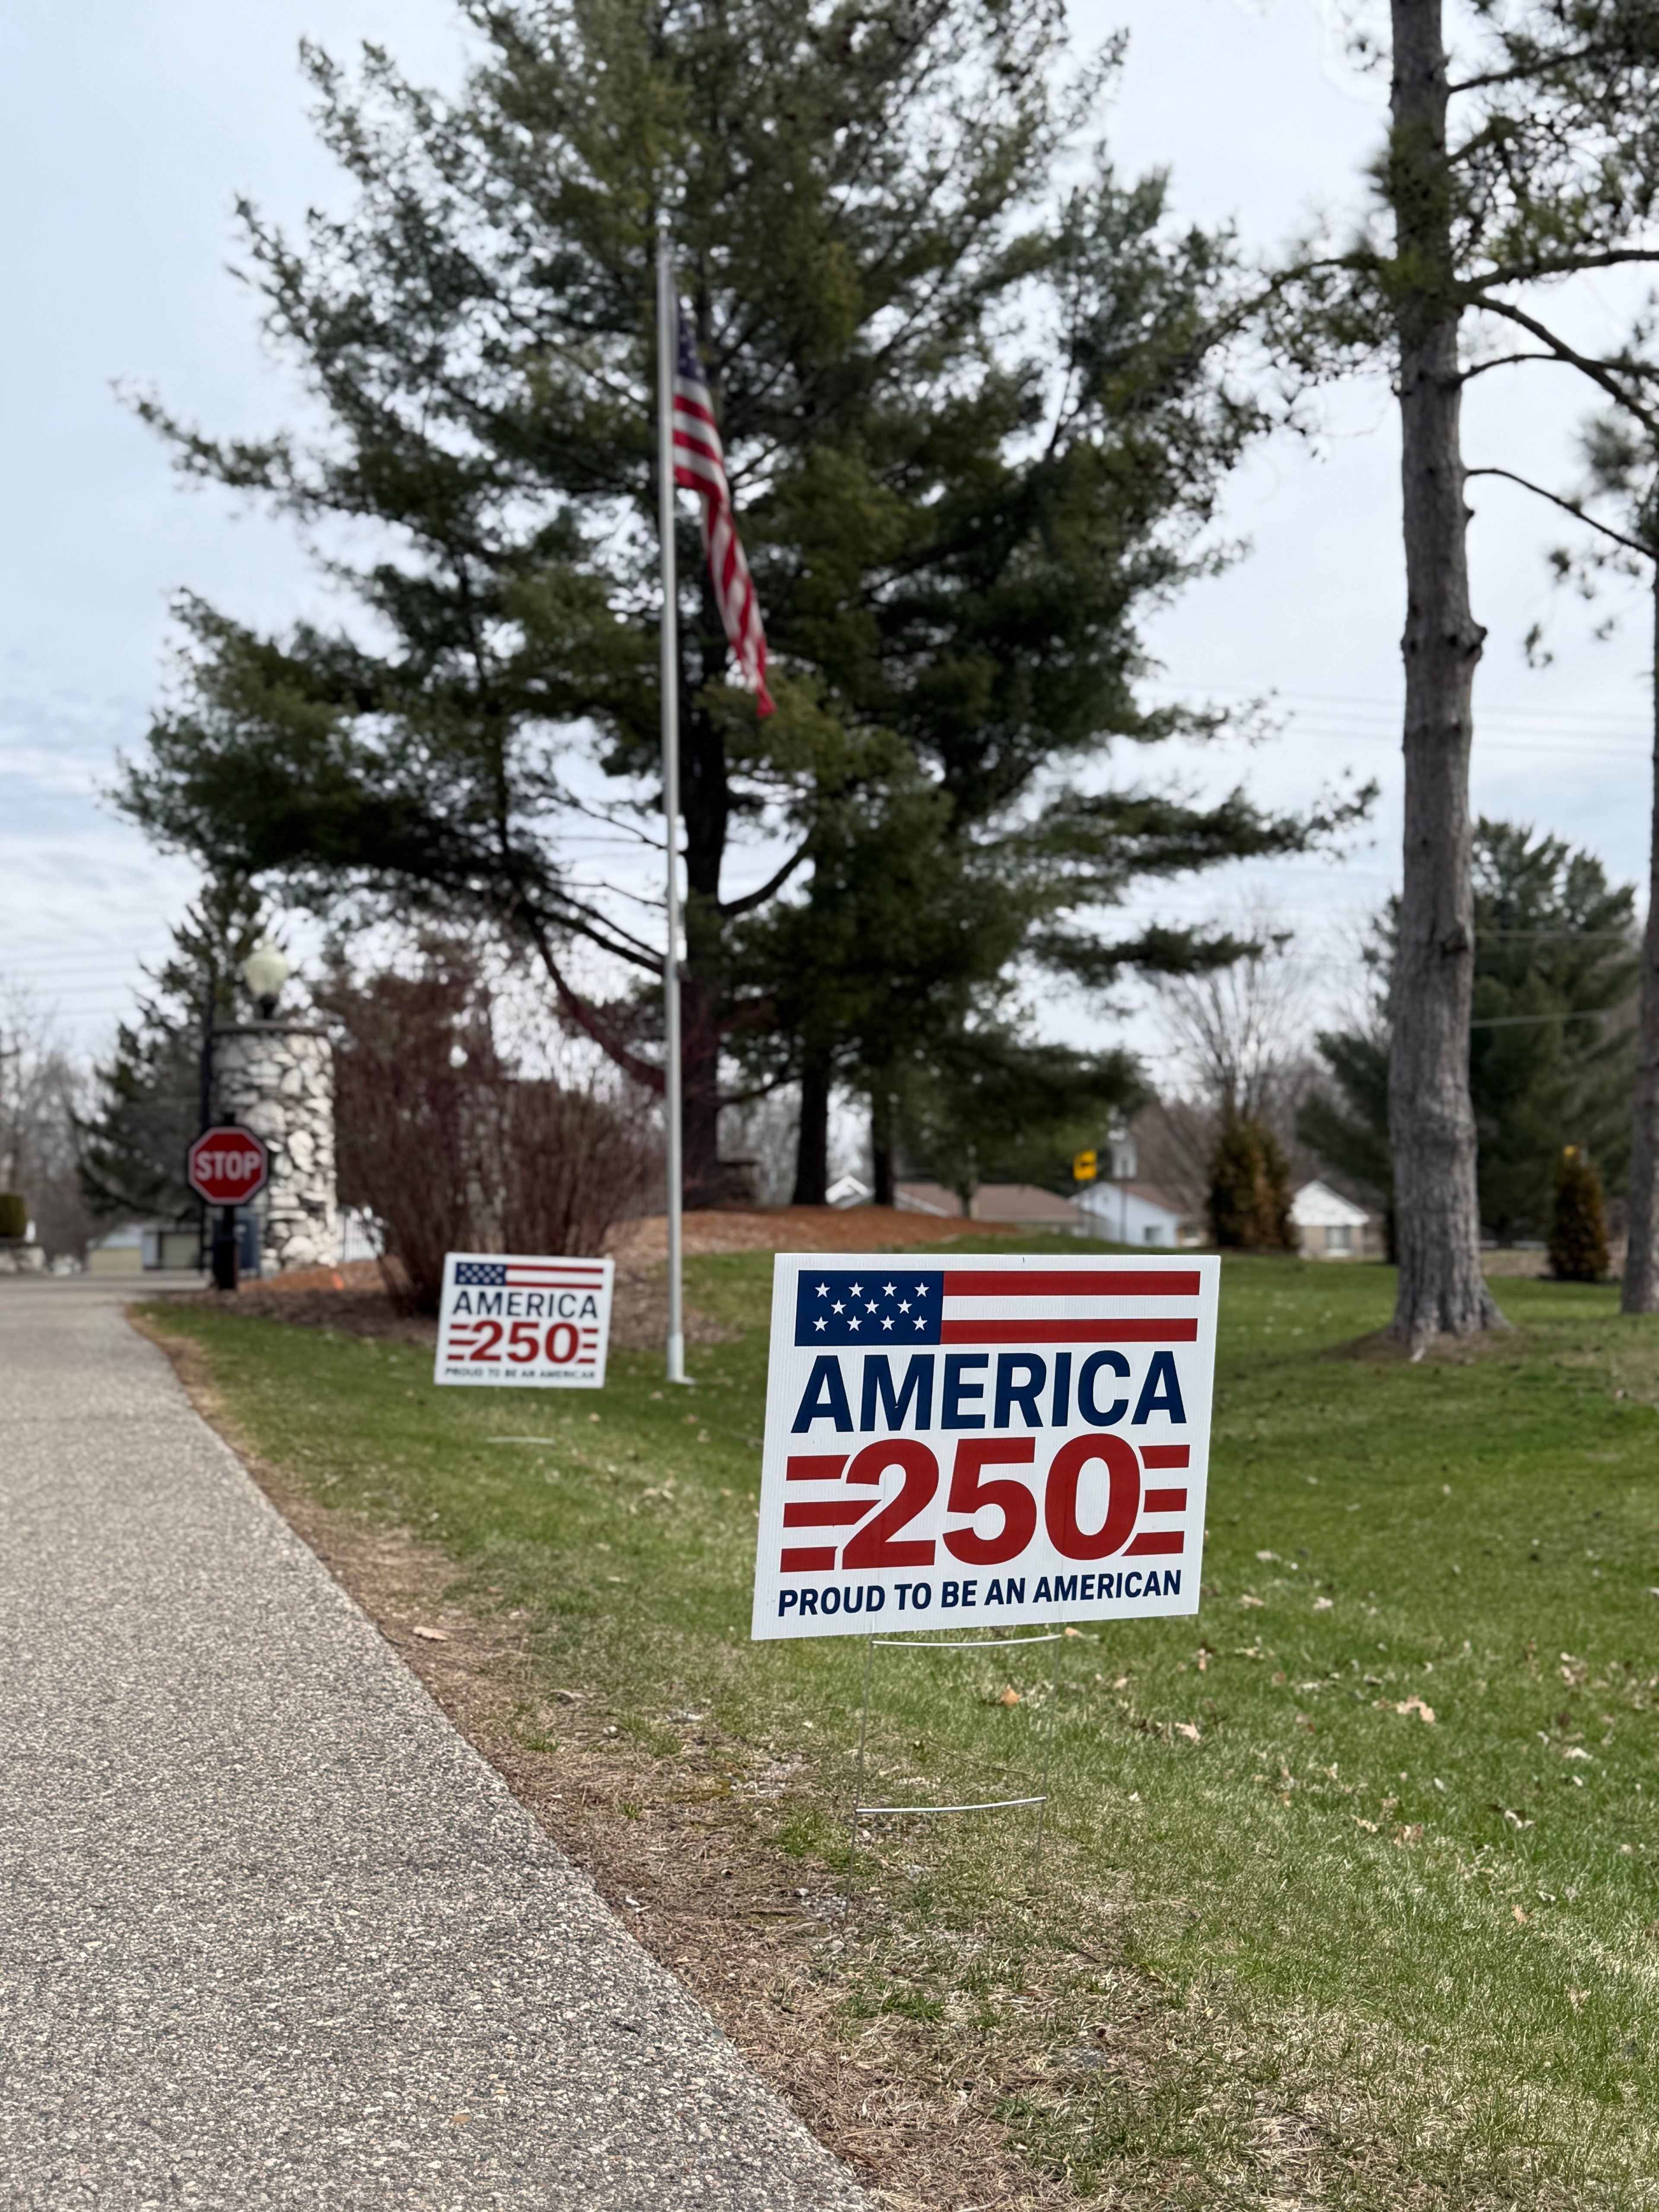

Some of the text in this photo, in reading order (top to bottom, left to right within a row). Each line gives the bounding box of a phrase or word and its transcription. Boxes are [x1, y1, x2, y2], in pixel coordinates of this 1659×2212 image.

[195, 1150, 260, 1182] STOP
[452, 1290, 598, 1319] AMERICA
[469, 1320, 579, 1364] 250
[791, 1350, 1187, 1433] AMERICA
[841, 1433, 1141, 1570] 250
[778, 1569, 1182, 1617] PROUD TO BE AN AMERICAN
